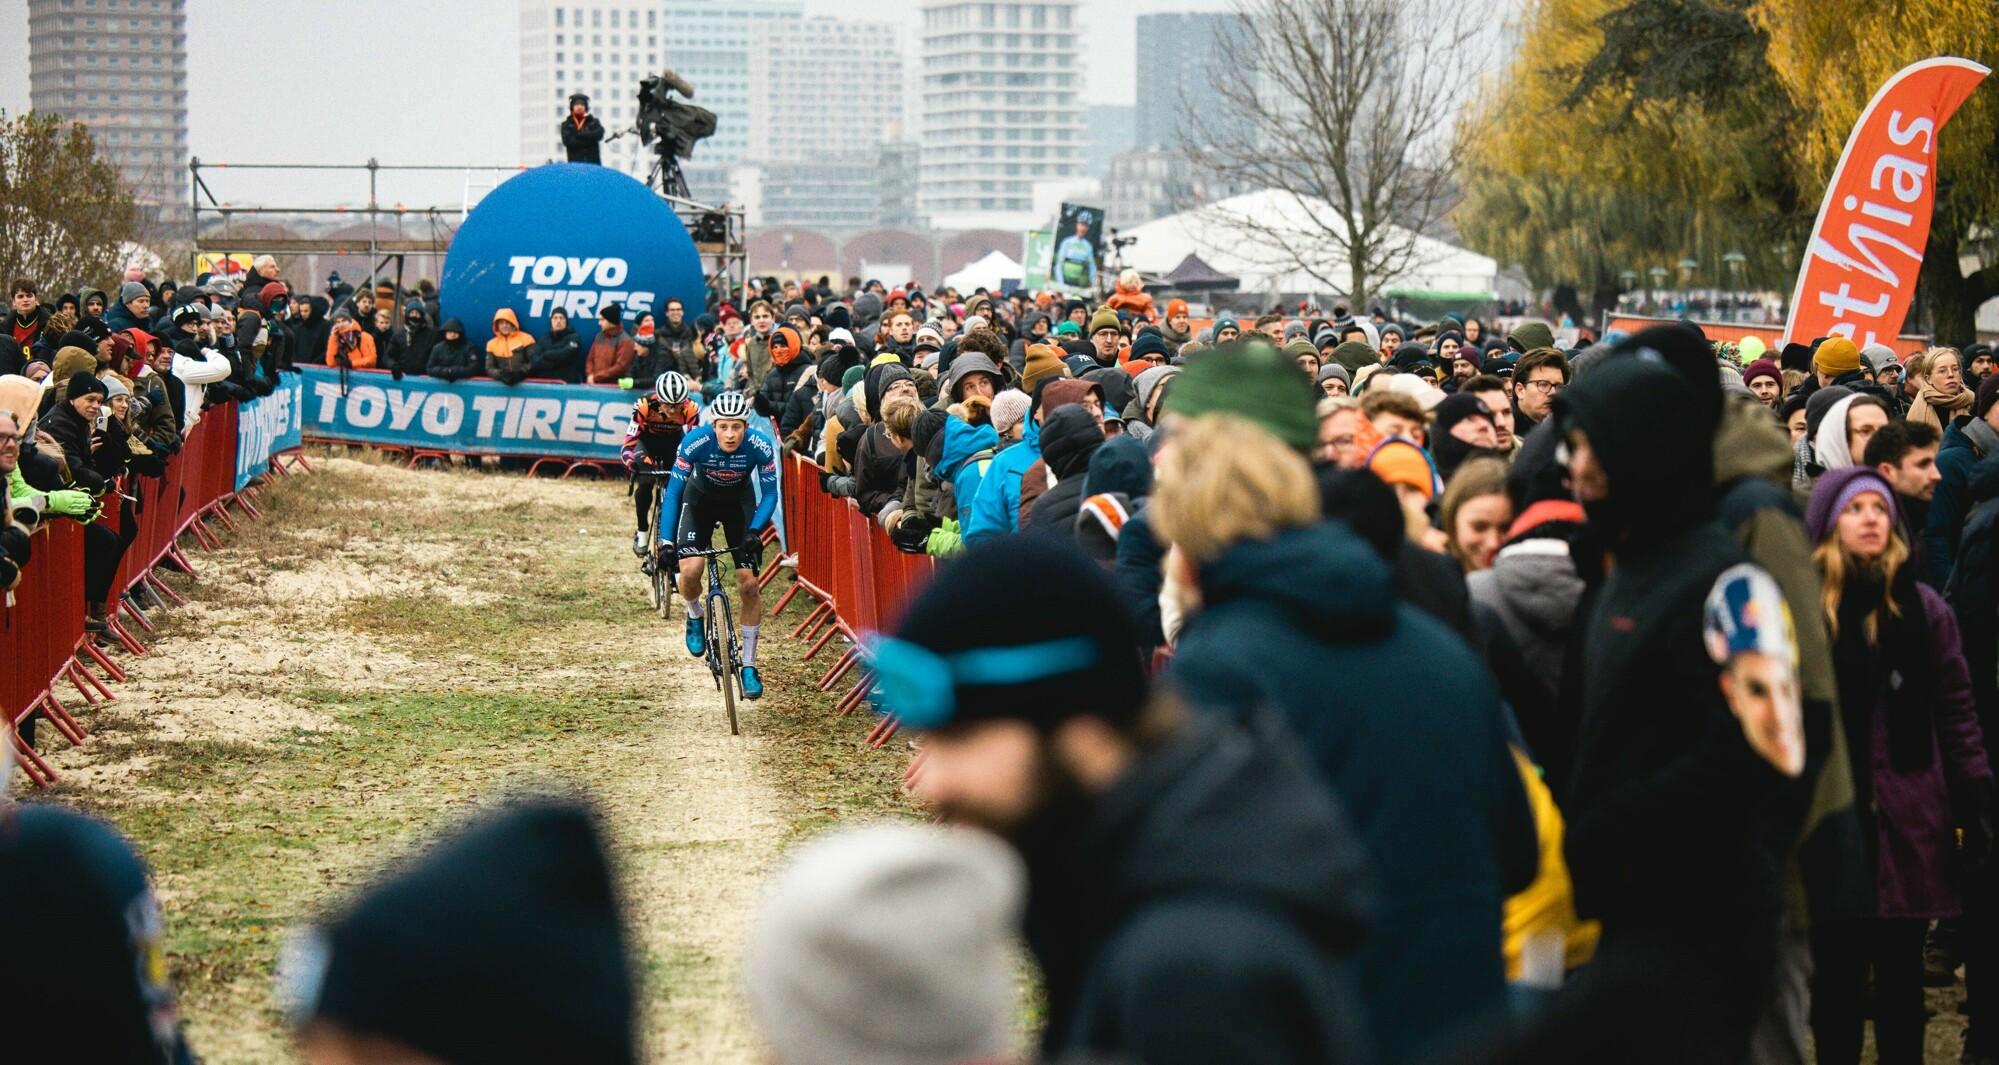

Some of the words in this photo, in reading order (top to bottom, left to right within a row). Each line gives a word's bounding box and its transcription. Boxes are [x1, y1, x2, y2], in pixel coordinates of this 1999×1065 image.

[508, 256, 628, 287] TOYO
[526, 289, 655, 320] TIRES
[314, 381, 465, 436] TOYO
[472, 395, 633, 446] TIRES
[748, 433, 773, 458] Alpecin
